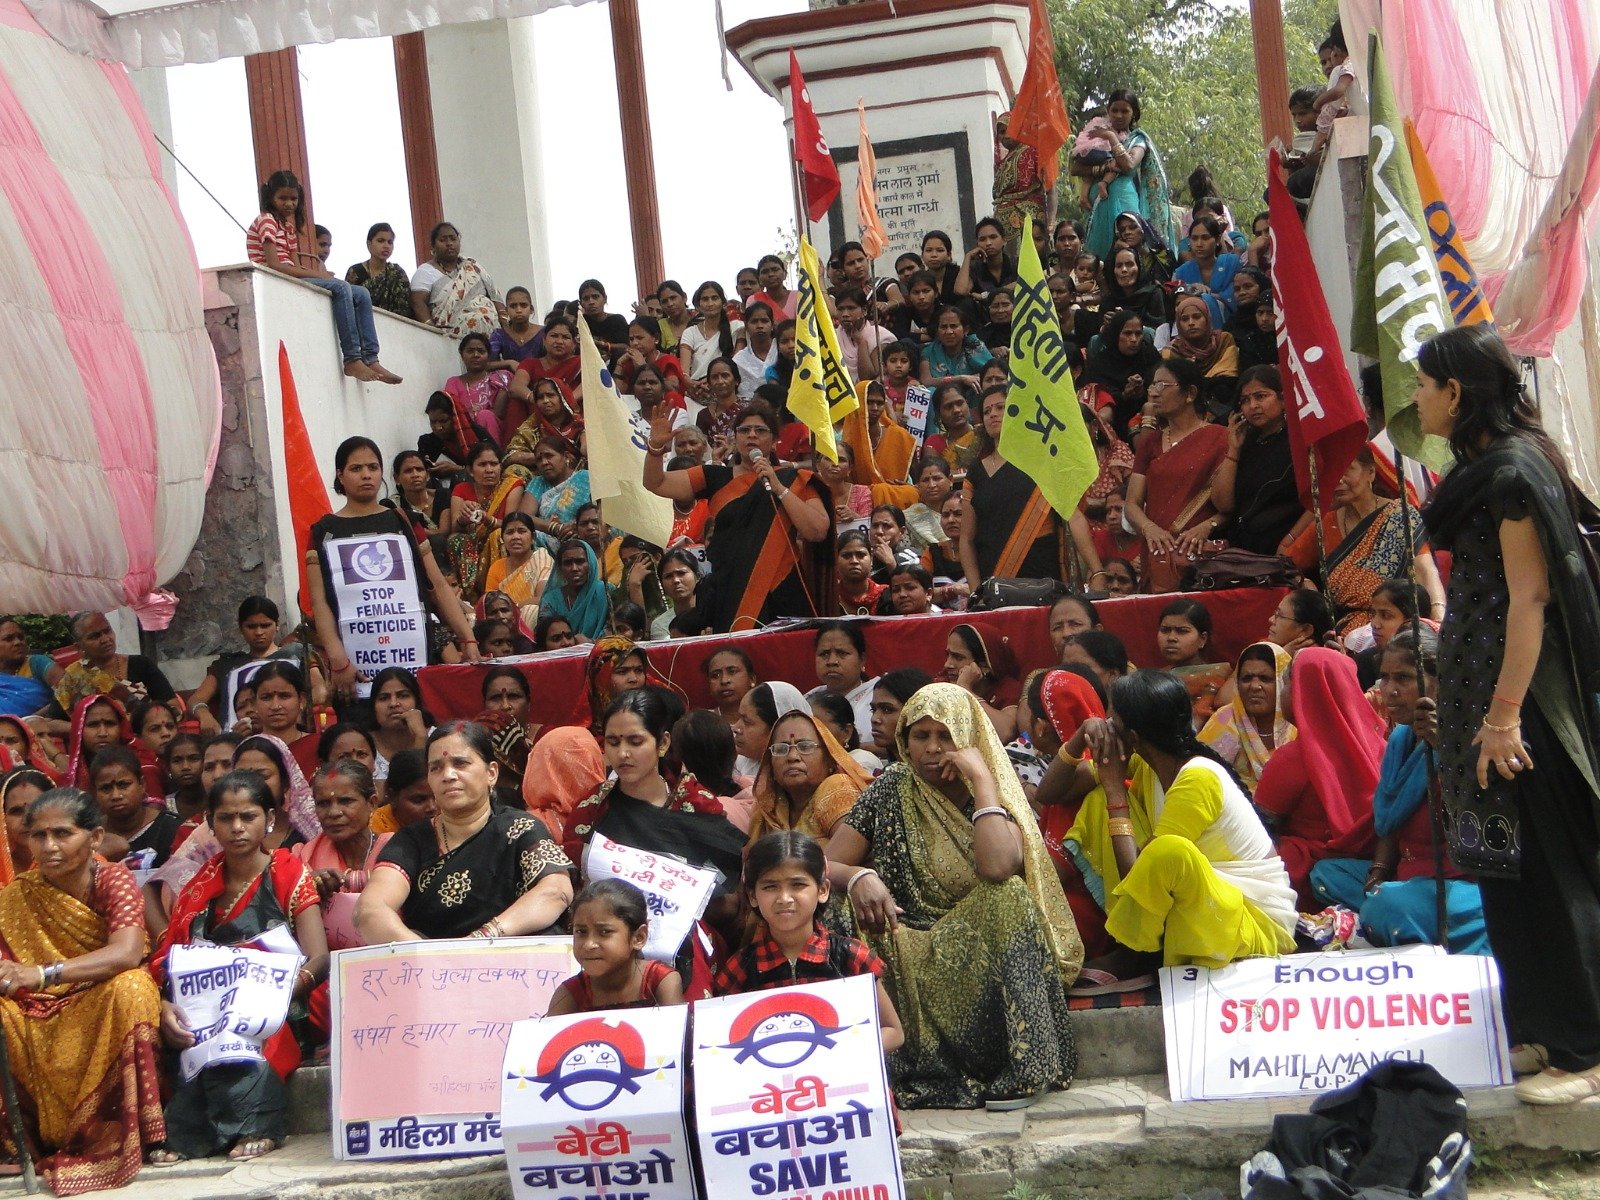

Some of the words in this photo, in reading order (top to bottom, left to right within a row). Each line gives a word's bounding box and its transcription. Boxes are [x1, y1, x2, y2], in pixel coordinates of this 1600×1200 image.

[915, 169, 941, 187] शर्मा
[907, 198, 940, 214] गान्धी
[907, 388, 929, 407] सिर्फ
[362, 587, 395, 601] STOP
[356, 602, 406, 618] FEMALE
[350, 619, 416, 634] FOETICIDE
[378, 635, 391, 645] OR
[355, 649, 387, 664] FACE
[390, 647, 416, 663] THE
[362, 968, 388, 1001] हर
[389, 962, 423, 989] जोर
[536, 969, 566, 990] पर
[1183, 967, 1199, 981] 3
[1274, 960, 1414, 986] Enough
[1220, 997, 1300, 1034] STOP
[1310, 992, 1472, 1030] VIOLENCE
[402, 1022, 461, 1049] हमारा
[749, 1075, 829, 1115] बेटी
[379, 1115, 458, 1149] महिला
[553, 1120, 632, 1157] बेटी
[711, 1099, 873, 1157] बचाओ
[519, 1148, 676, 1190] बचाओ
[748, 1150, 852, 1196] SAVE
